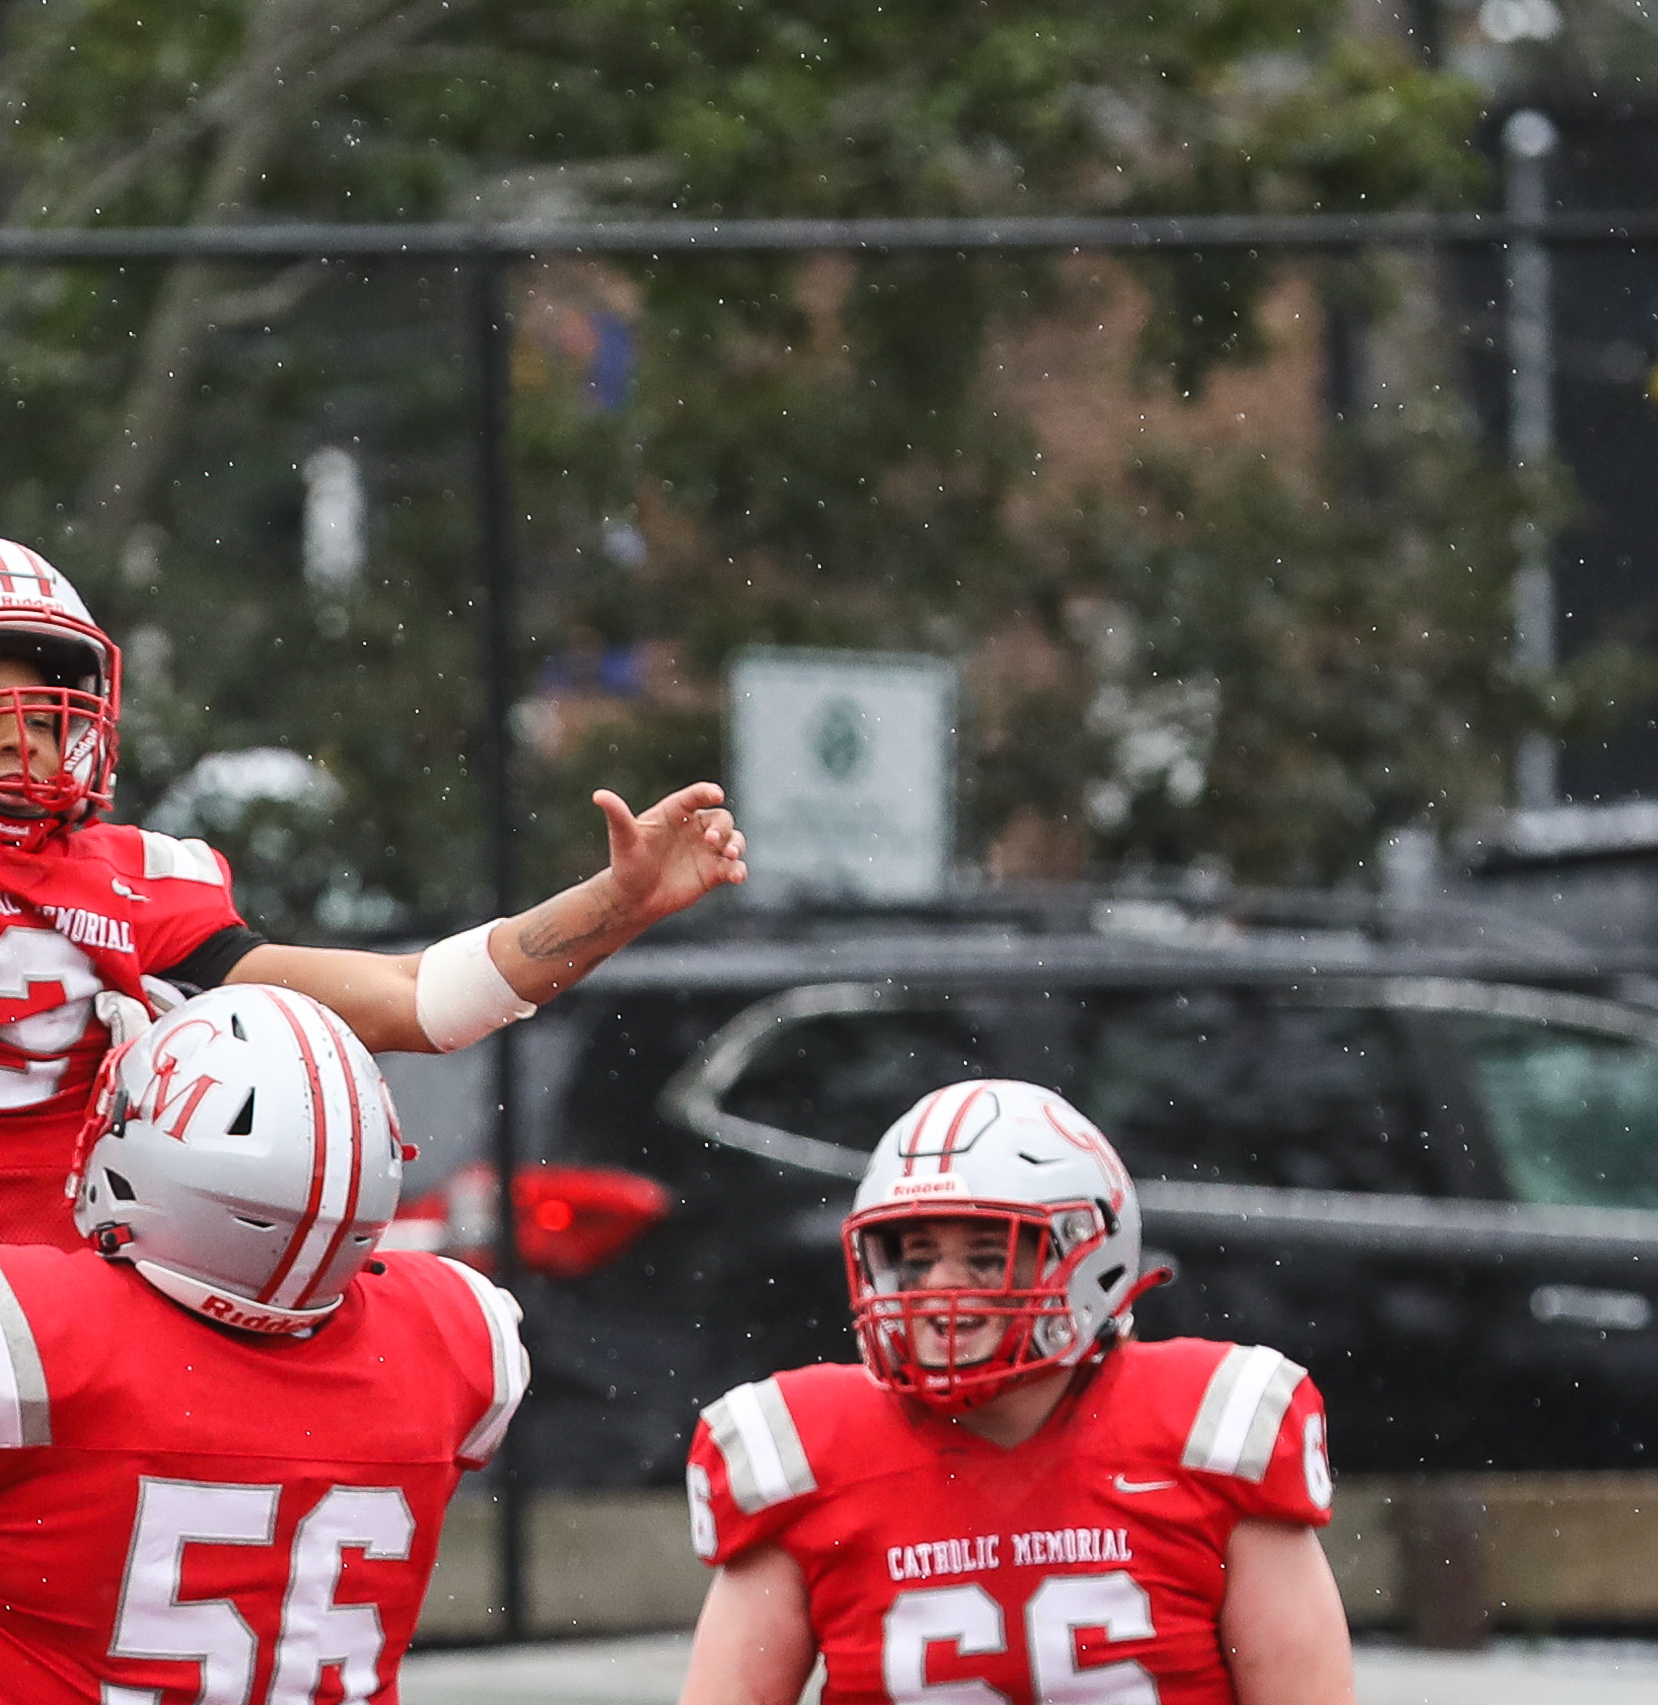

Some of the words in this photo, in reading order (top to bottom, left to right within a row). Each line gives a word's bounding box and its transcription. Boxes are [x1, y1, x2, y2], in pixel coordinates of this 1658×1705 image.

[35, 905, 135, 954] MORIAL
[201, 1293, 310, 1333] Ridd
[887, 1534, 1000, 1581] CATHOLIC
[1011, 1528, 1133, 1566] MEMORIAL
